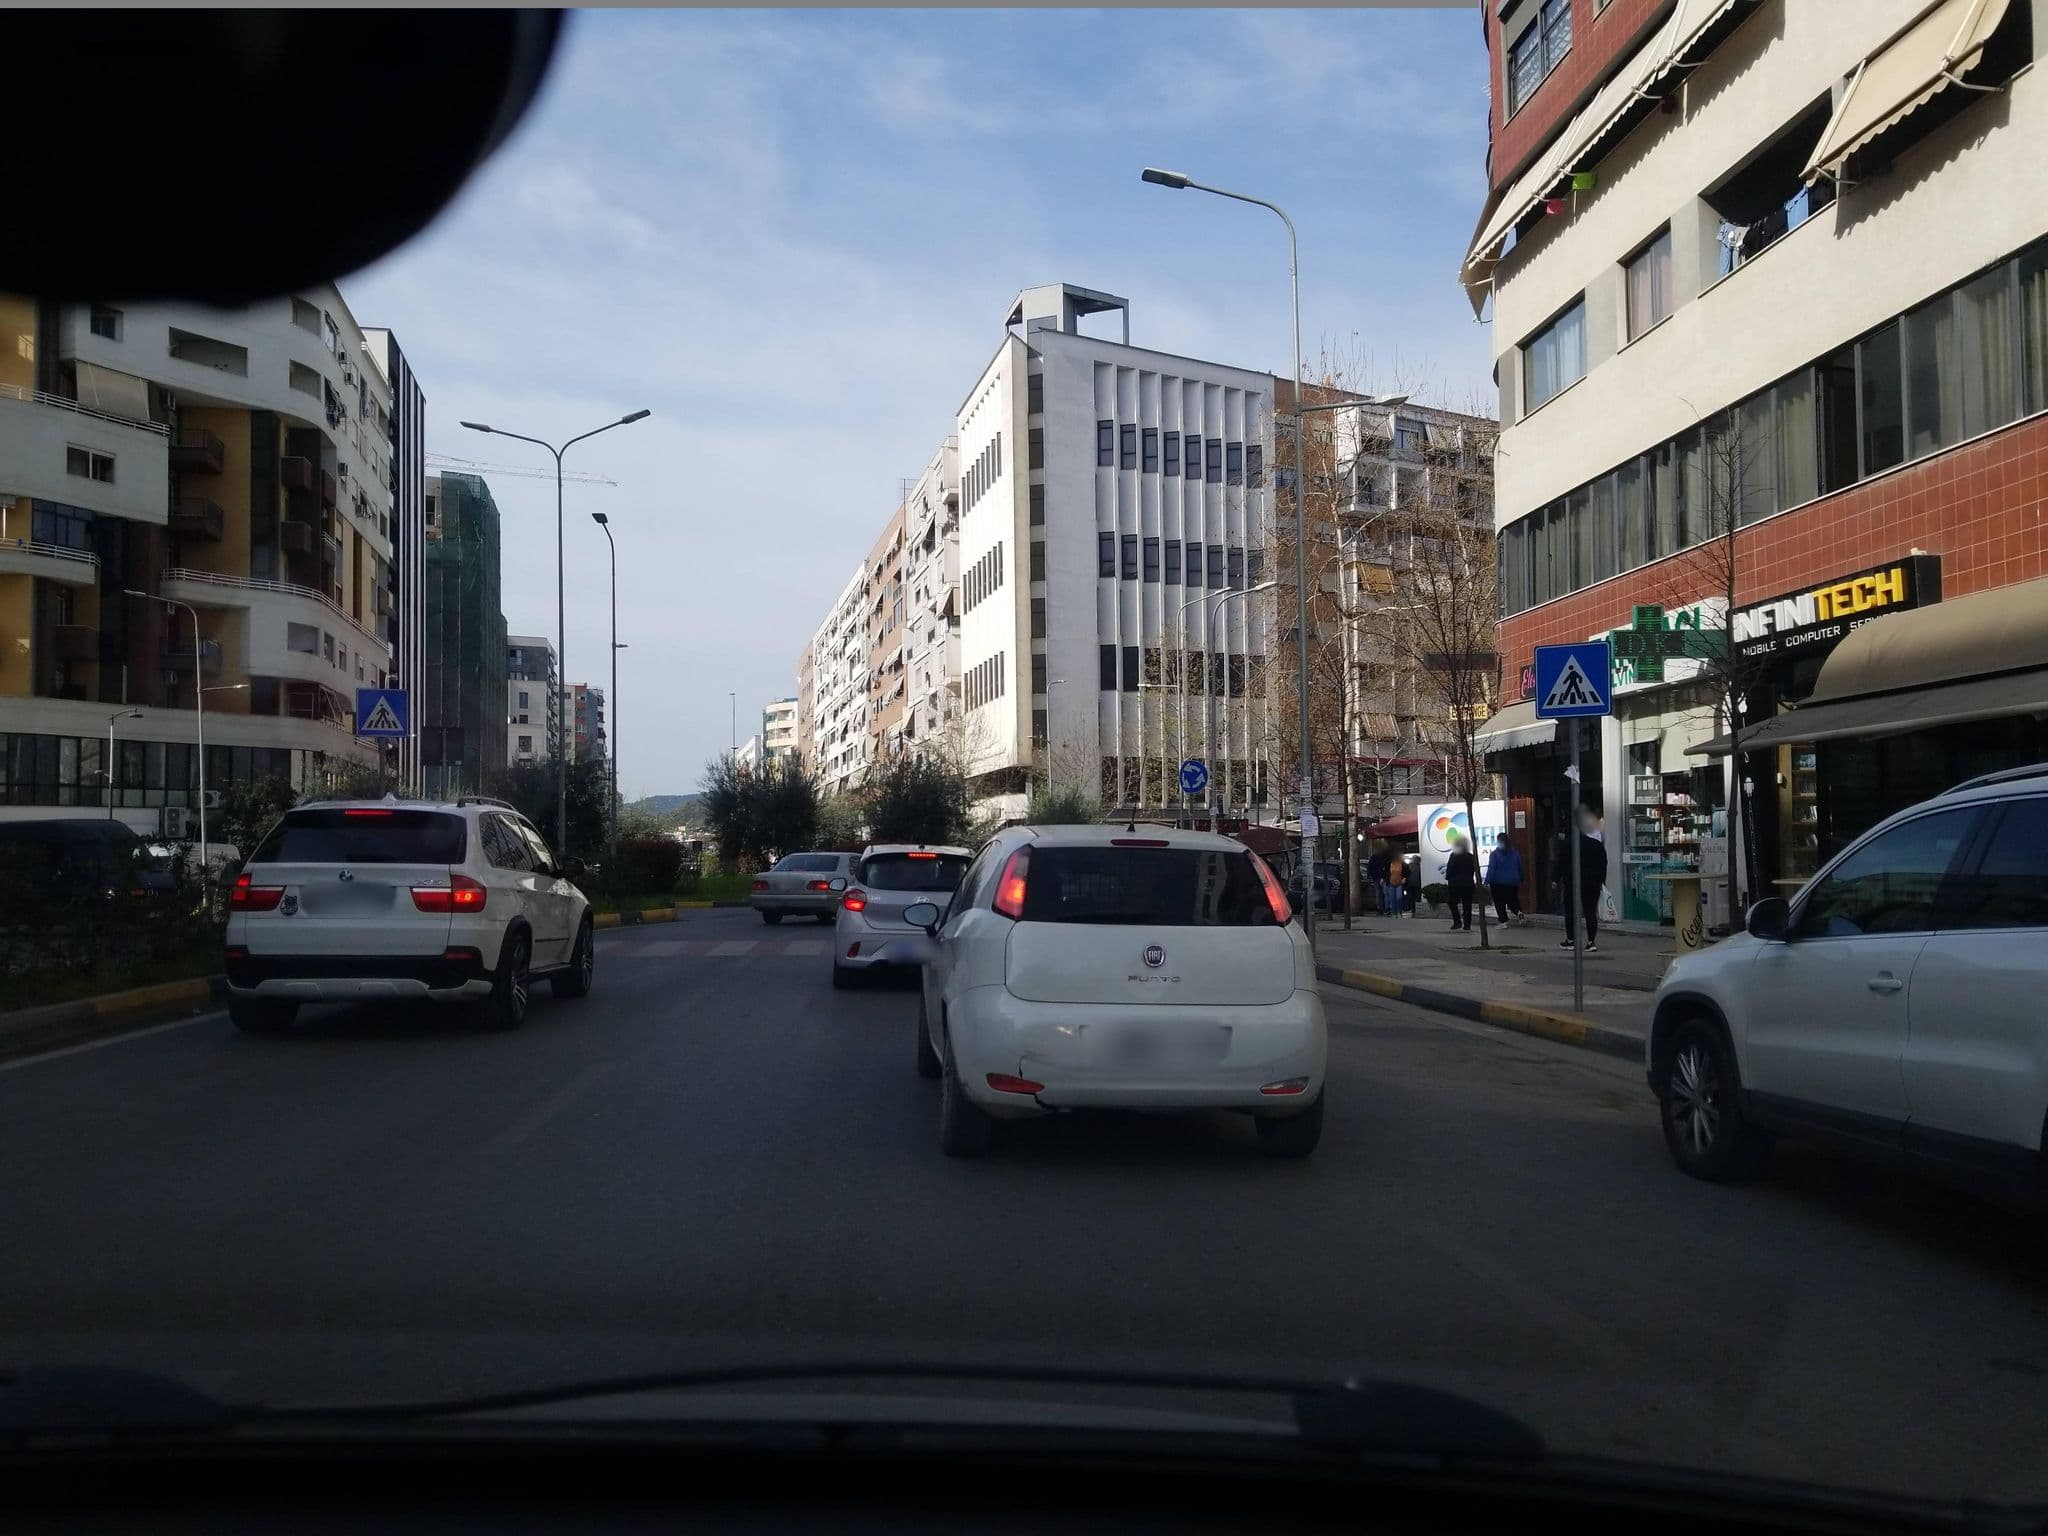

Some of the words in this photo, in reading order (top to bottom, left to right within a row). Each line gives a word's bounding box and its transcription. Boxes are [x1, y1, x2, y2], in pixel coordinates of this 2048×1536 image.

[1743, 641, 1777, 656] MOBILE
[1785, 625, 1841, 647] COMPUTER
[1148, 950, 1161, 961] FIAT
